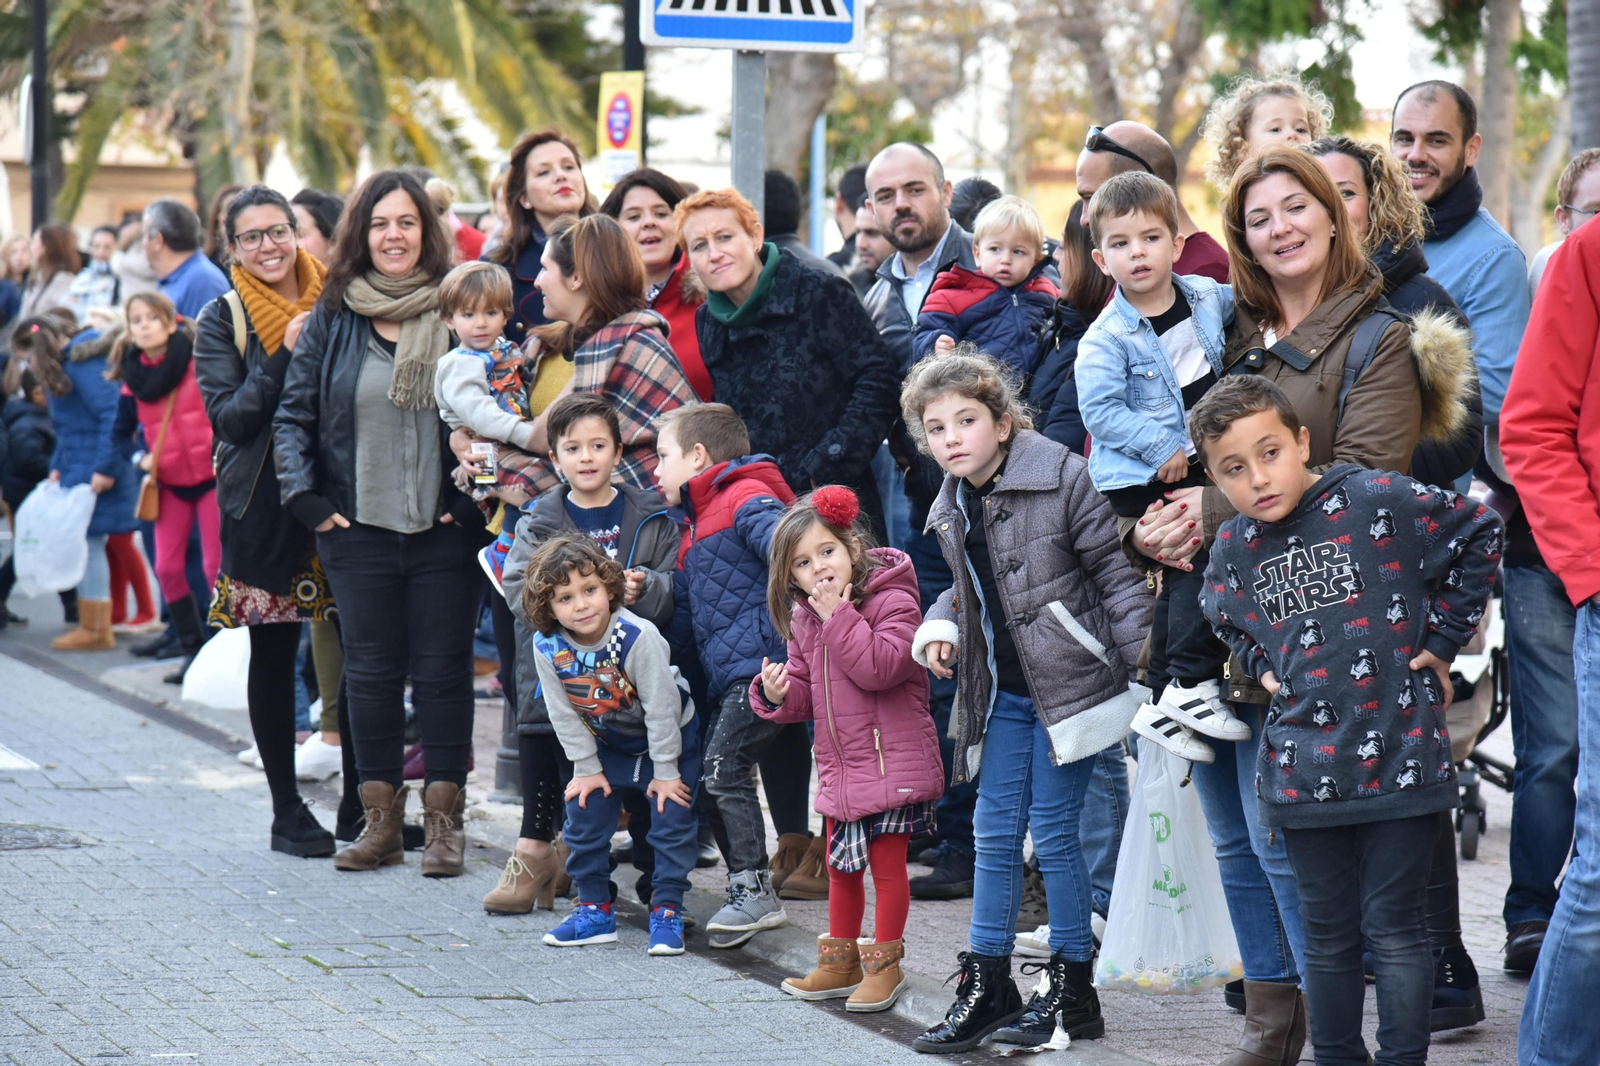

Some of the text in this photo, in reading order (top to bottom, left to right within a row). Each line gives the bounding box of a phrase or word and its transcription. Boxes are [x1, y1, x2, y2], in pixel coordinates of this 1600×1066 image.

[1365, 477, 1391, 487] DARK
[1366, 484, 1392, 496] SIDE
[1253, 541, 1351, 593] STAR
[1378, 561, 1401, 573] DARK
[1379, 570, 1401, 583] SIDE
[1276, 575, 1309, 593] LAST
[1259, 573, 1355, 626] WARS
[1343, 617, 1370, 631] DARK
[1344, 625, 1371, 640] SIDE
[1305, 667, 1328, 680] DARK
[1306, 677, 1329, 690] SIDE
[1354, 700, 1379, 713] DARK
[1355, 709, 1379, 722] SIDE
[1313, 753, 1335, 764] SIDE
